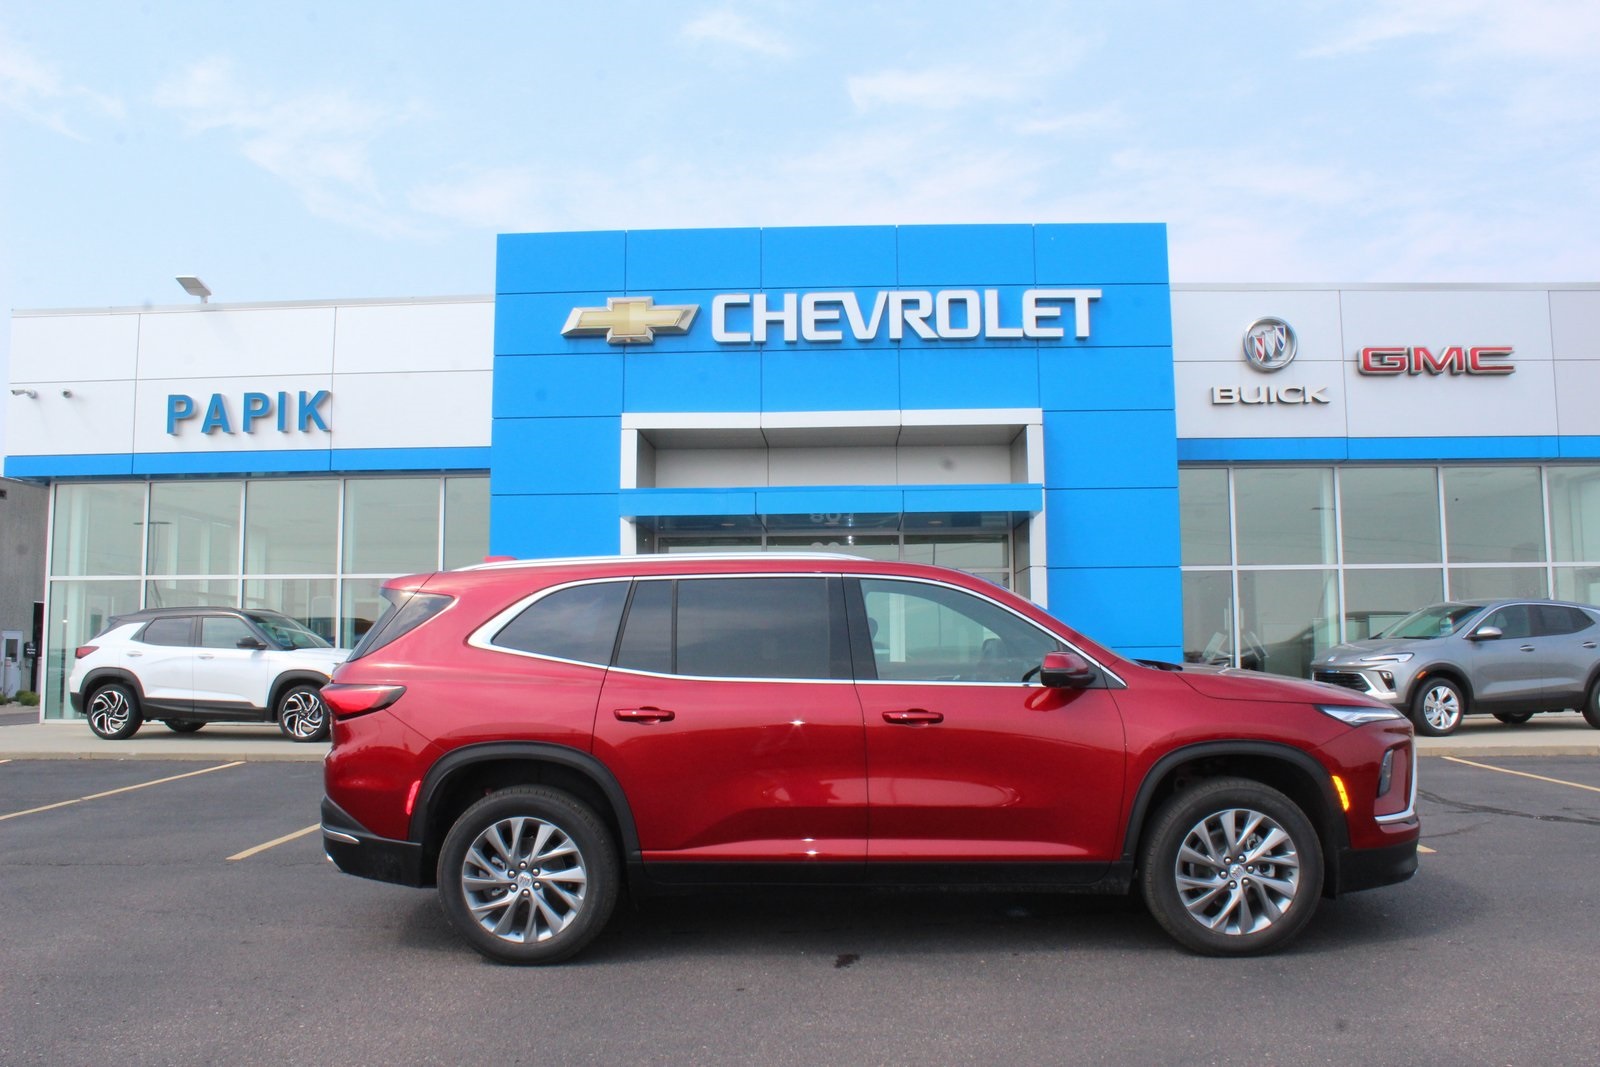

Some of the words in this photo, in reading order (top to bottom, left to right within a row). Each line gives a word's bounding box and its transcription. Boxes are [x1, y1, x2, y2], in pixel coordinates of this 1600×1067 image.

[711, 289, 1102, 343] CHEVROLET
[1357, 346, 1515, 376] GMC
[167, 389, 331, 436] PAPIK
[1211, 386, 1331, 405] BUICK
